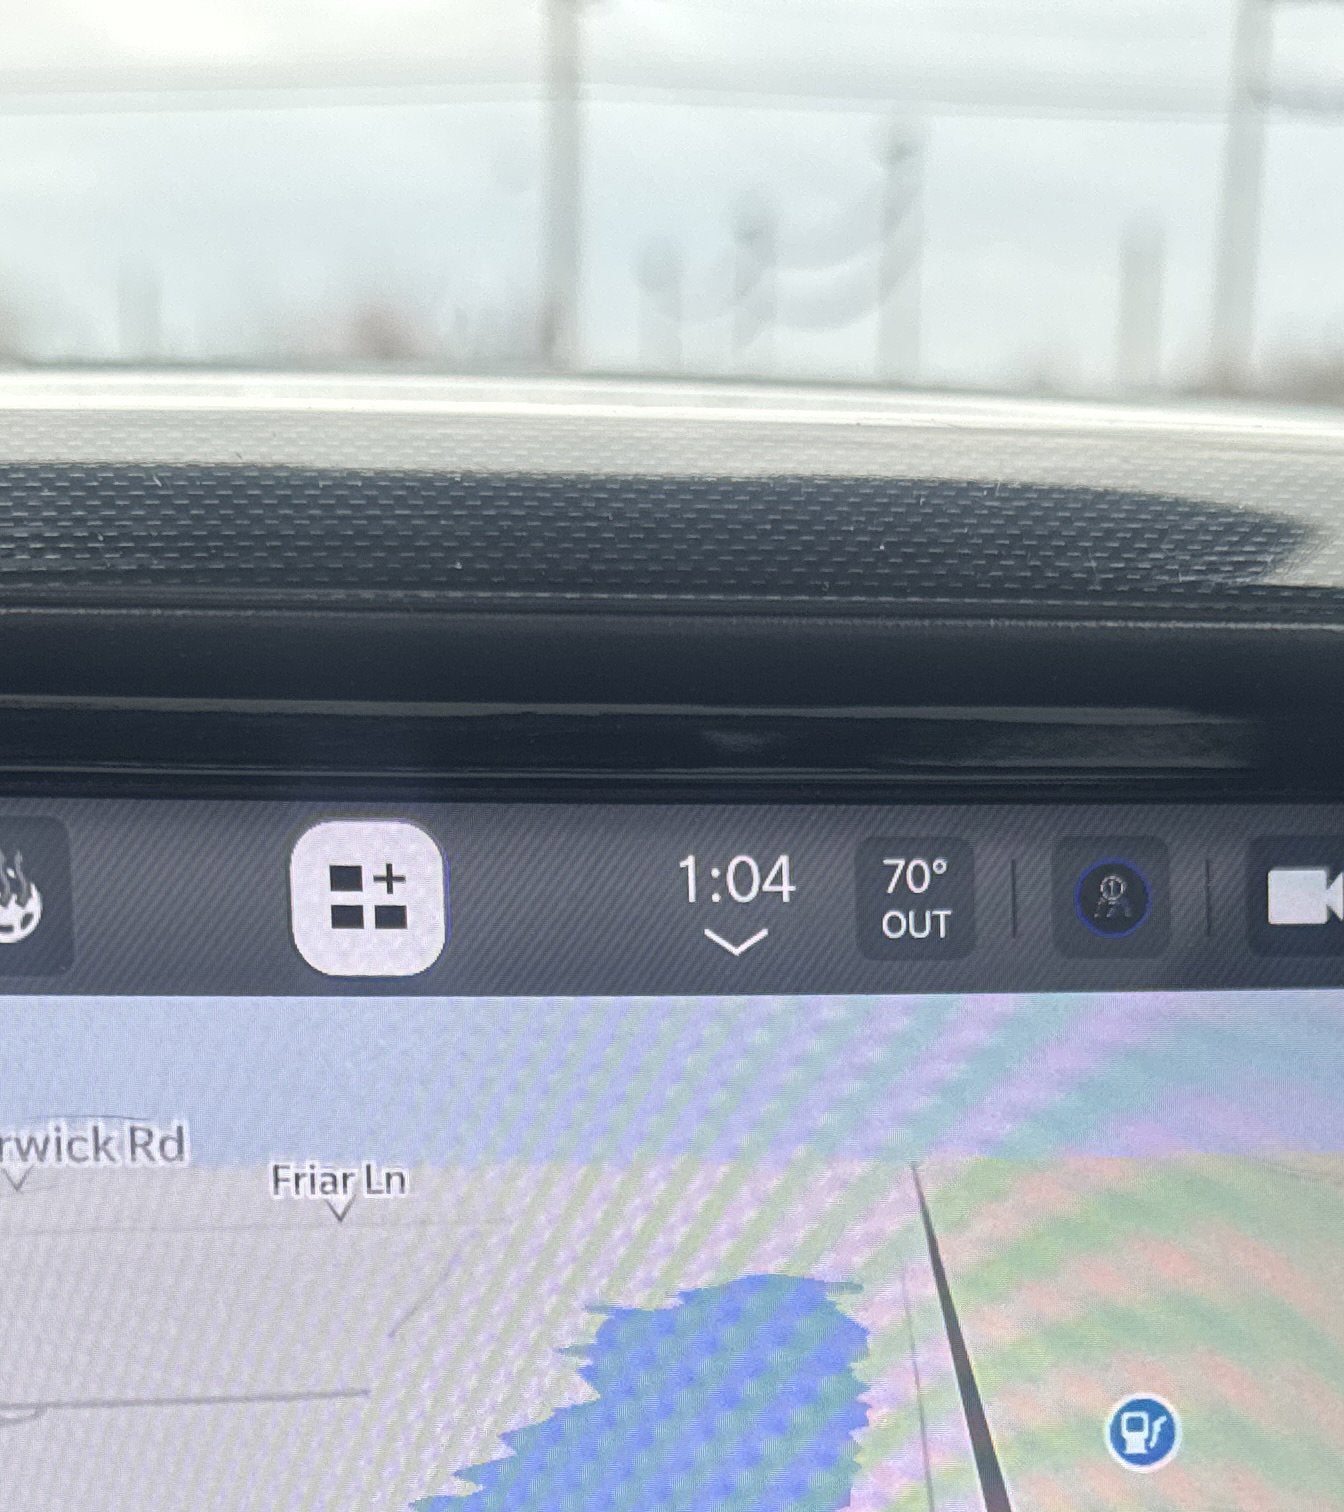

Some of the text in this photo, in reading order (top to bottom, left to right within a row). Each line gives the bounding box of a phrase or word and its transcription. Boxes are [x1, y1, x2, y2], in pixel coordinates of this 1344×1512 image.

[678, 854, 796, 903] 1:04
[882, 859, 948, 894] 70°
[881, 910, 952, 939] OUT
[131, 1123, 184, 1163] Rd
[272, 1164, 406, 1197] Friar Ln
